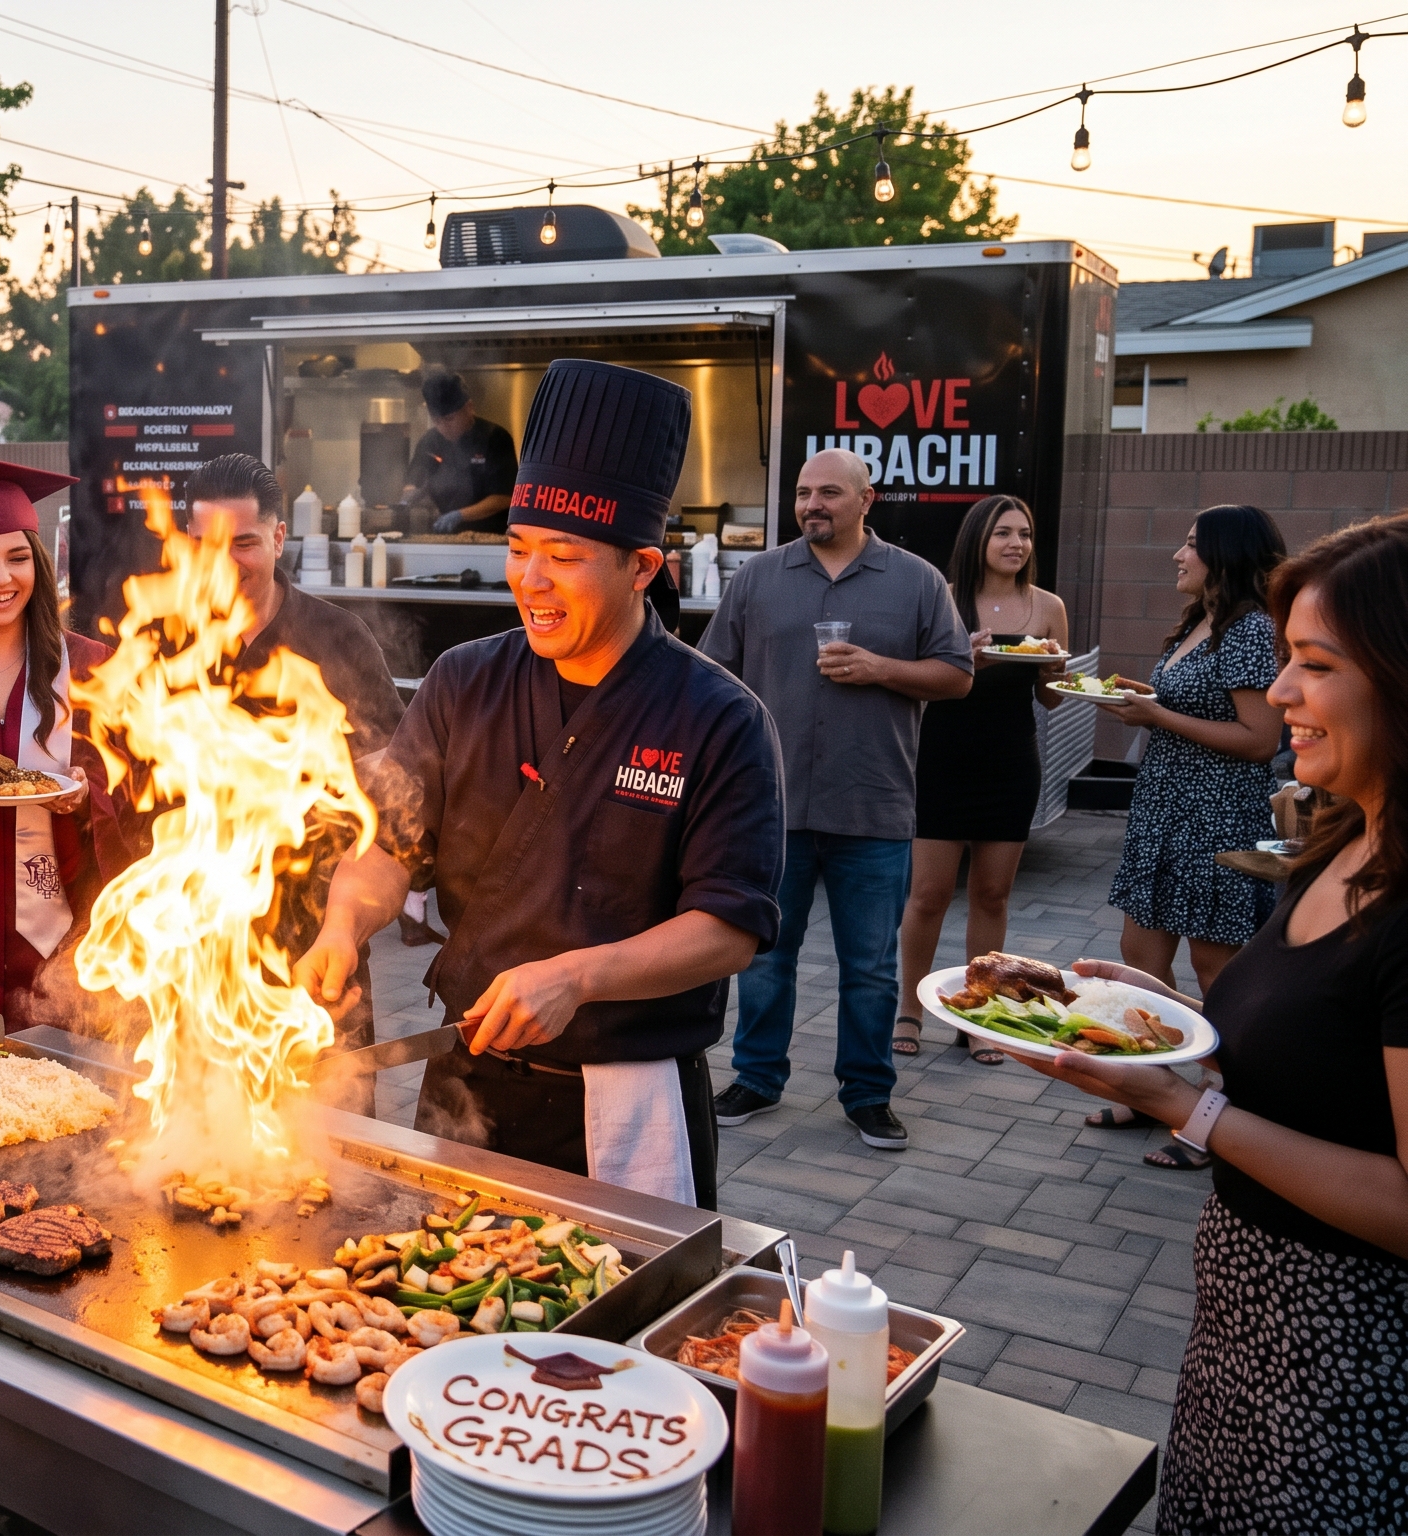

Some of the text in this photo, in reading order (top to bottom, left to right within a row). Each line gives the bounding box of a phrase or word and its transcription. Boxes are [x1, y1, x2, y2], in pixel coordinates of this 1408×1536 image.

[806, 434, 997, 486] BACHI
[533, 484, 618, 525] HIBACHI
[615, 765, 685, 799] HIBACHI
[443, 1375, 688, 1445] CONGRATS
[443, 1416, 650, 1480] GRADS
